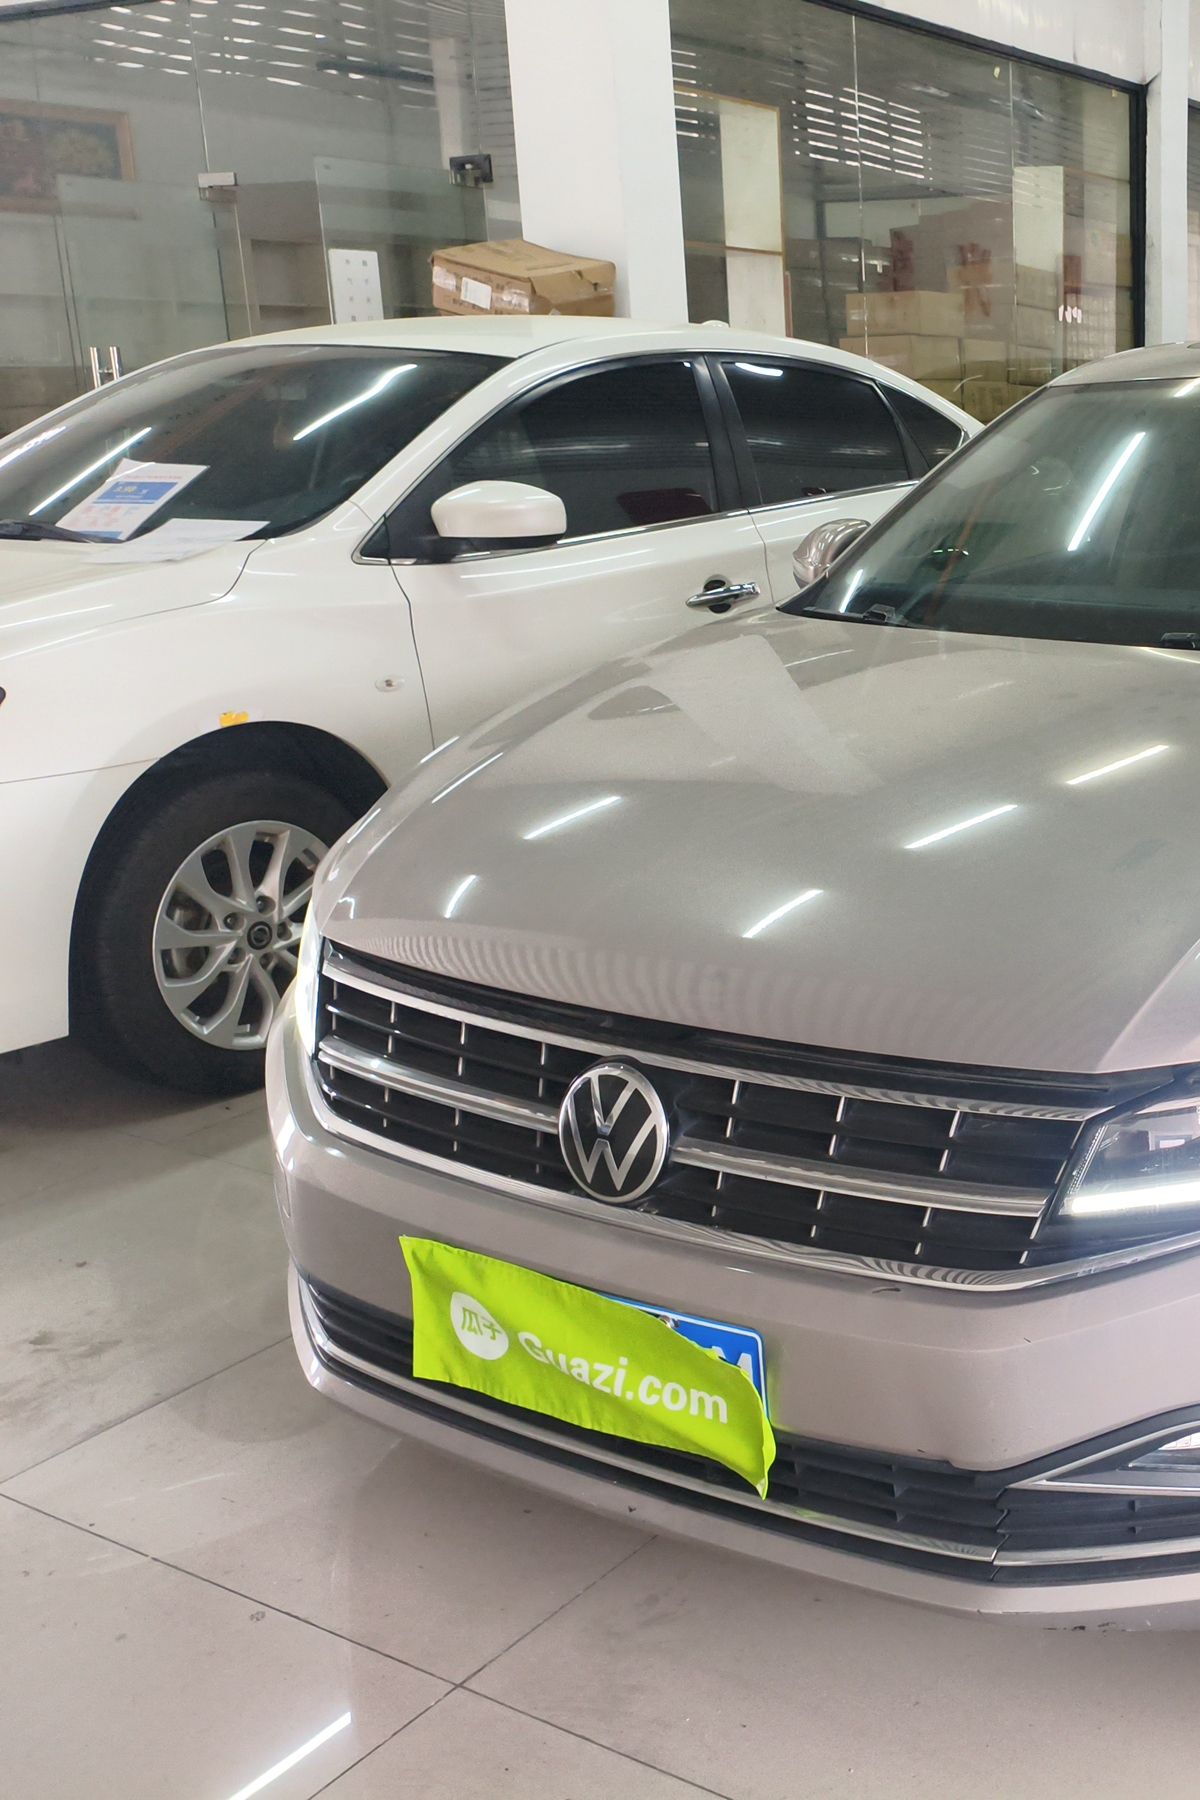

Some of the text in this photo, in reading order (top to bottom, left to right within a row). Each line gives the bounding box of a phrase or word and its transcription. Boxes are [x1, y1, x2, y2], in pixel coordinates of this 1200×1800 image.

[562, 1067, 663, 1198] VW
[461, 1306, 503, 1341] 瓜子
[518, 1331, 728, 1424] Guazi.com
